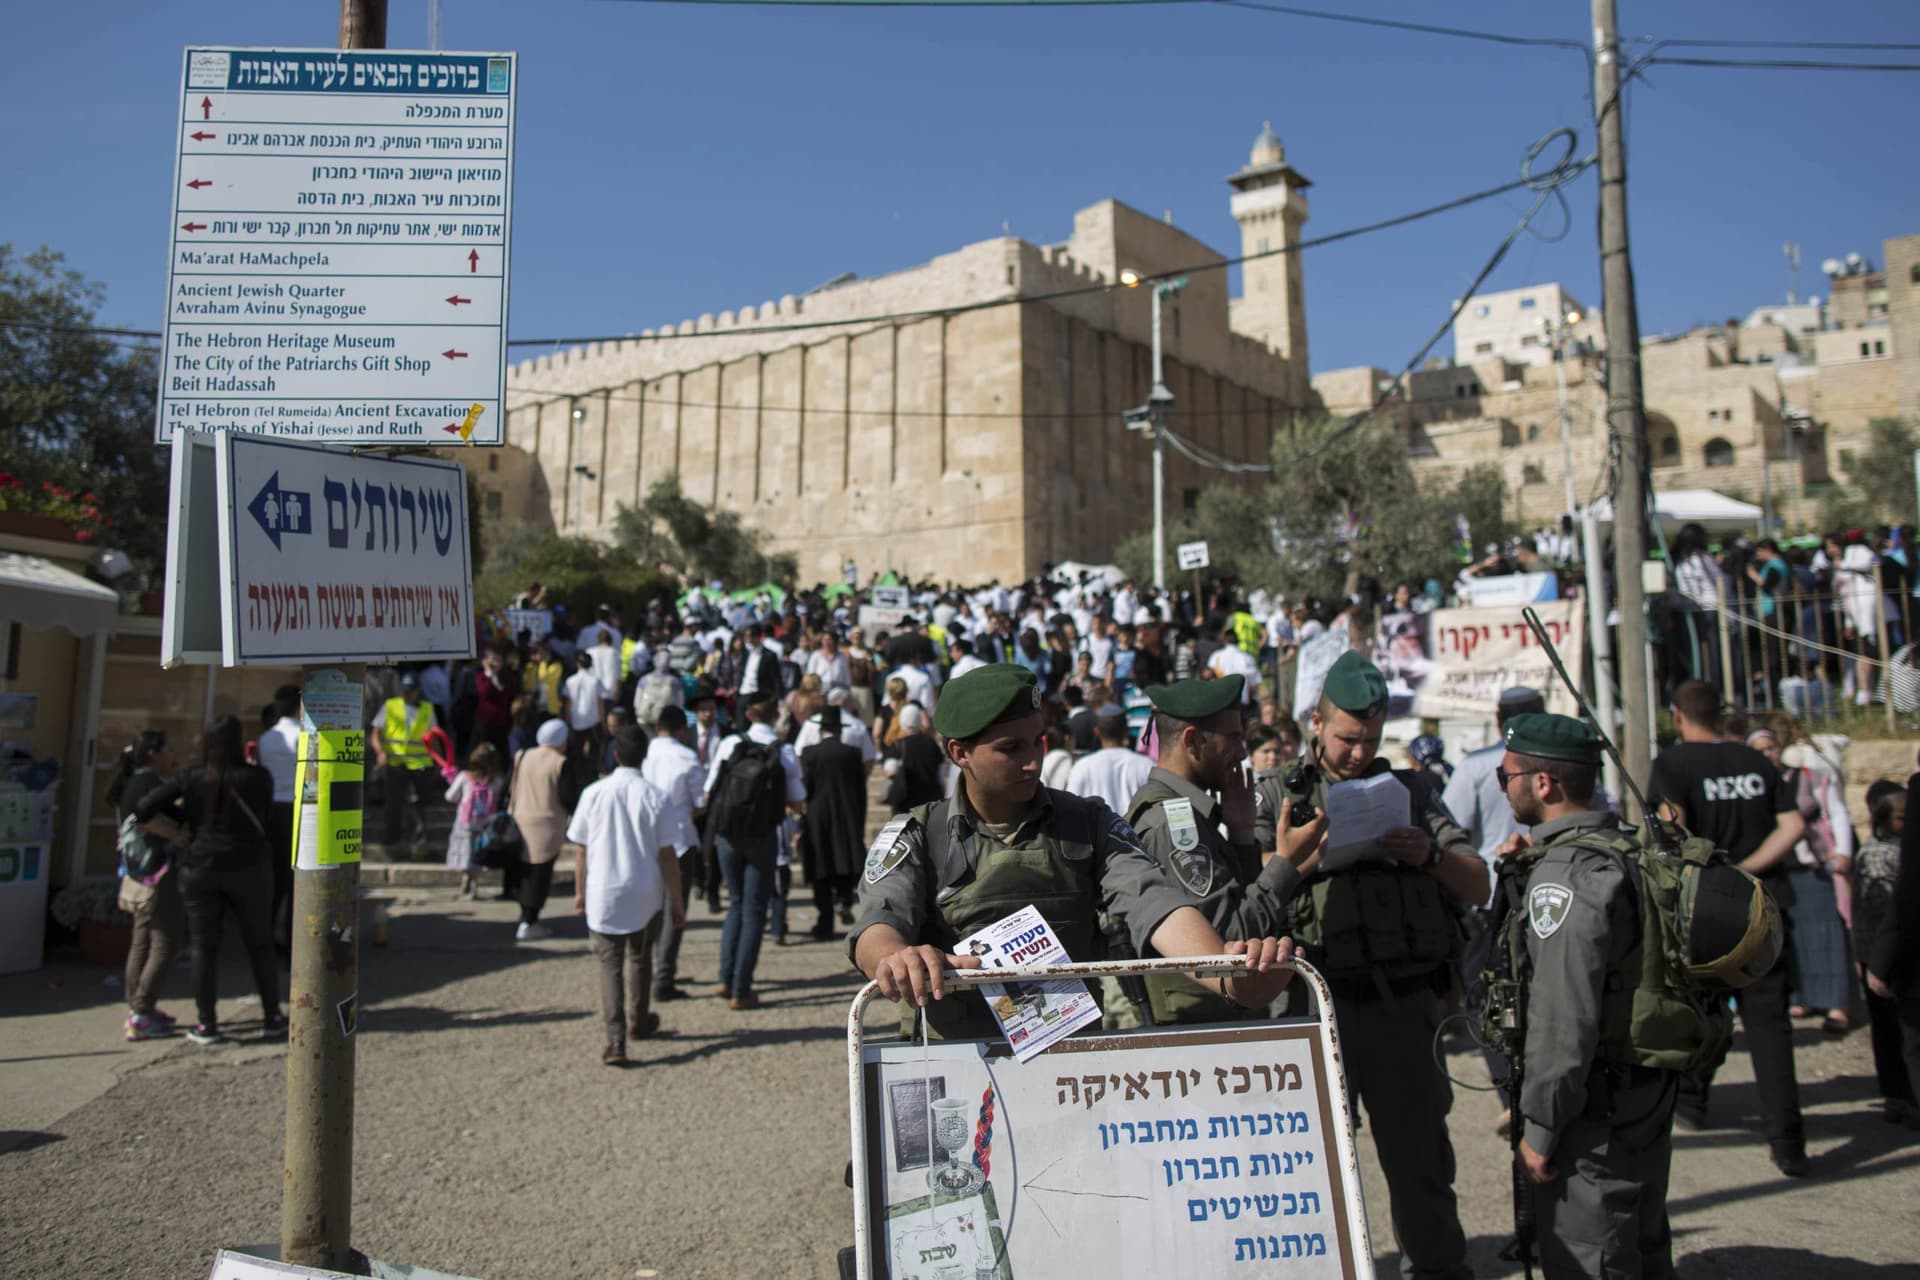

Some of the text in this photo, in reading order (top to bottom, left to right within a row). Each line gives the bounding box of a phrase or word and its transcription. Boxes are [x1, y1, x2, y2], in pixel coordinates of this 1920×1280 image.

[237, 59, 299, 85] האבות
[304, 53, 348, 88] לעיר
[354, 62, 412, 87] הבאים
[418, 64, 480, 88] ברוכים
[406, 104, 503, 118] מערת המכפלה
[227, 132, 502, 151] הרובע היהודי העתיק, בית הכנסת אברהם אבינו
[312, 166, 501, 183] מוזיאון היישוב היהודי בחברון
[298, 192, 500, 208] ומזכרות עיר האבות, בית הדסה
[212, 220, 238, 234] ורות
[242, 221, 262, 234] ישי
[268, 222, 290, 237] קבר
[336, 220, 352, 235] תל
[356, 223, 400, 238] עתיקות
[405, 223, 430, 236] אתר
[461, 224, 500, 236] אדמות
[240, 251, 329, 269] HaMachpela
[177, 283, 345, 300] Ancient Jewish Quarter
[176, 300, 366, 319] Avraham Avinu Synagogue
[176, 332, 395, 352] The Hebron Heritage Museum
[174, 354, 430, 376] The City of the Patriarchs Gift Shop
[172, 376, 276, 392] Beit Hadassah
[169, 402, 190, 416] Tel
[196, 403, 250, 416] Hebron
[254, 406, 274, 418] (Tel
[278, 406, 332, 418] Rumeida)
[334, 404, 390, 417] Ancient
[252, 422, 266, 434] of
[271, 422, 313, 435] Yishai
[317, 424, 354, 436] (Jesse)
[357, 422, 384, 435] and
[390, 422, 422, 435] Ruth
[324, 474, 452, 557] שירותים
[248, 581, 311, 636] המערה
[317, 582, 366, 628] בשטח
[372, 581, 432, 628] שירותים
[438, 584, 460, 630] אין
[1000, 924, 1046, 954] סעודת
[1010, 936, 1052, 964] משיח
[1056, 1063, 1302, 1110] מרכז יודאיקה
[1098, 1111, 1309, 1150] מזכרות מחברון
[1163, 1150, 1314, 1187] יינות חברון
[1187, 1192, 1320, 1222] תכשיטים
[919, 1244, 956, 1264] שבת
[1235, 1233, 1326, 1261] מתנות
